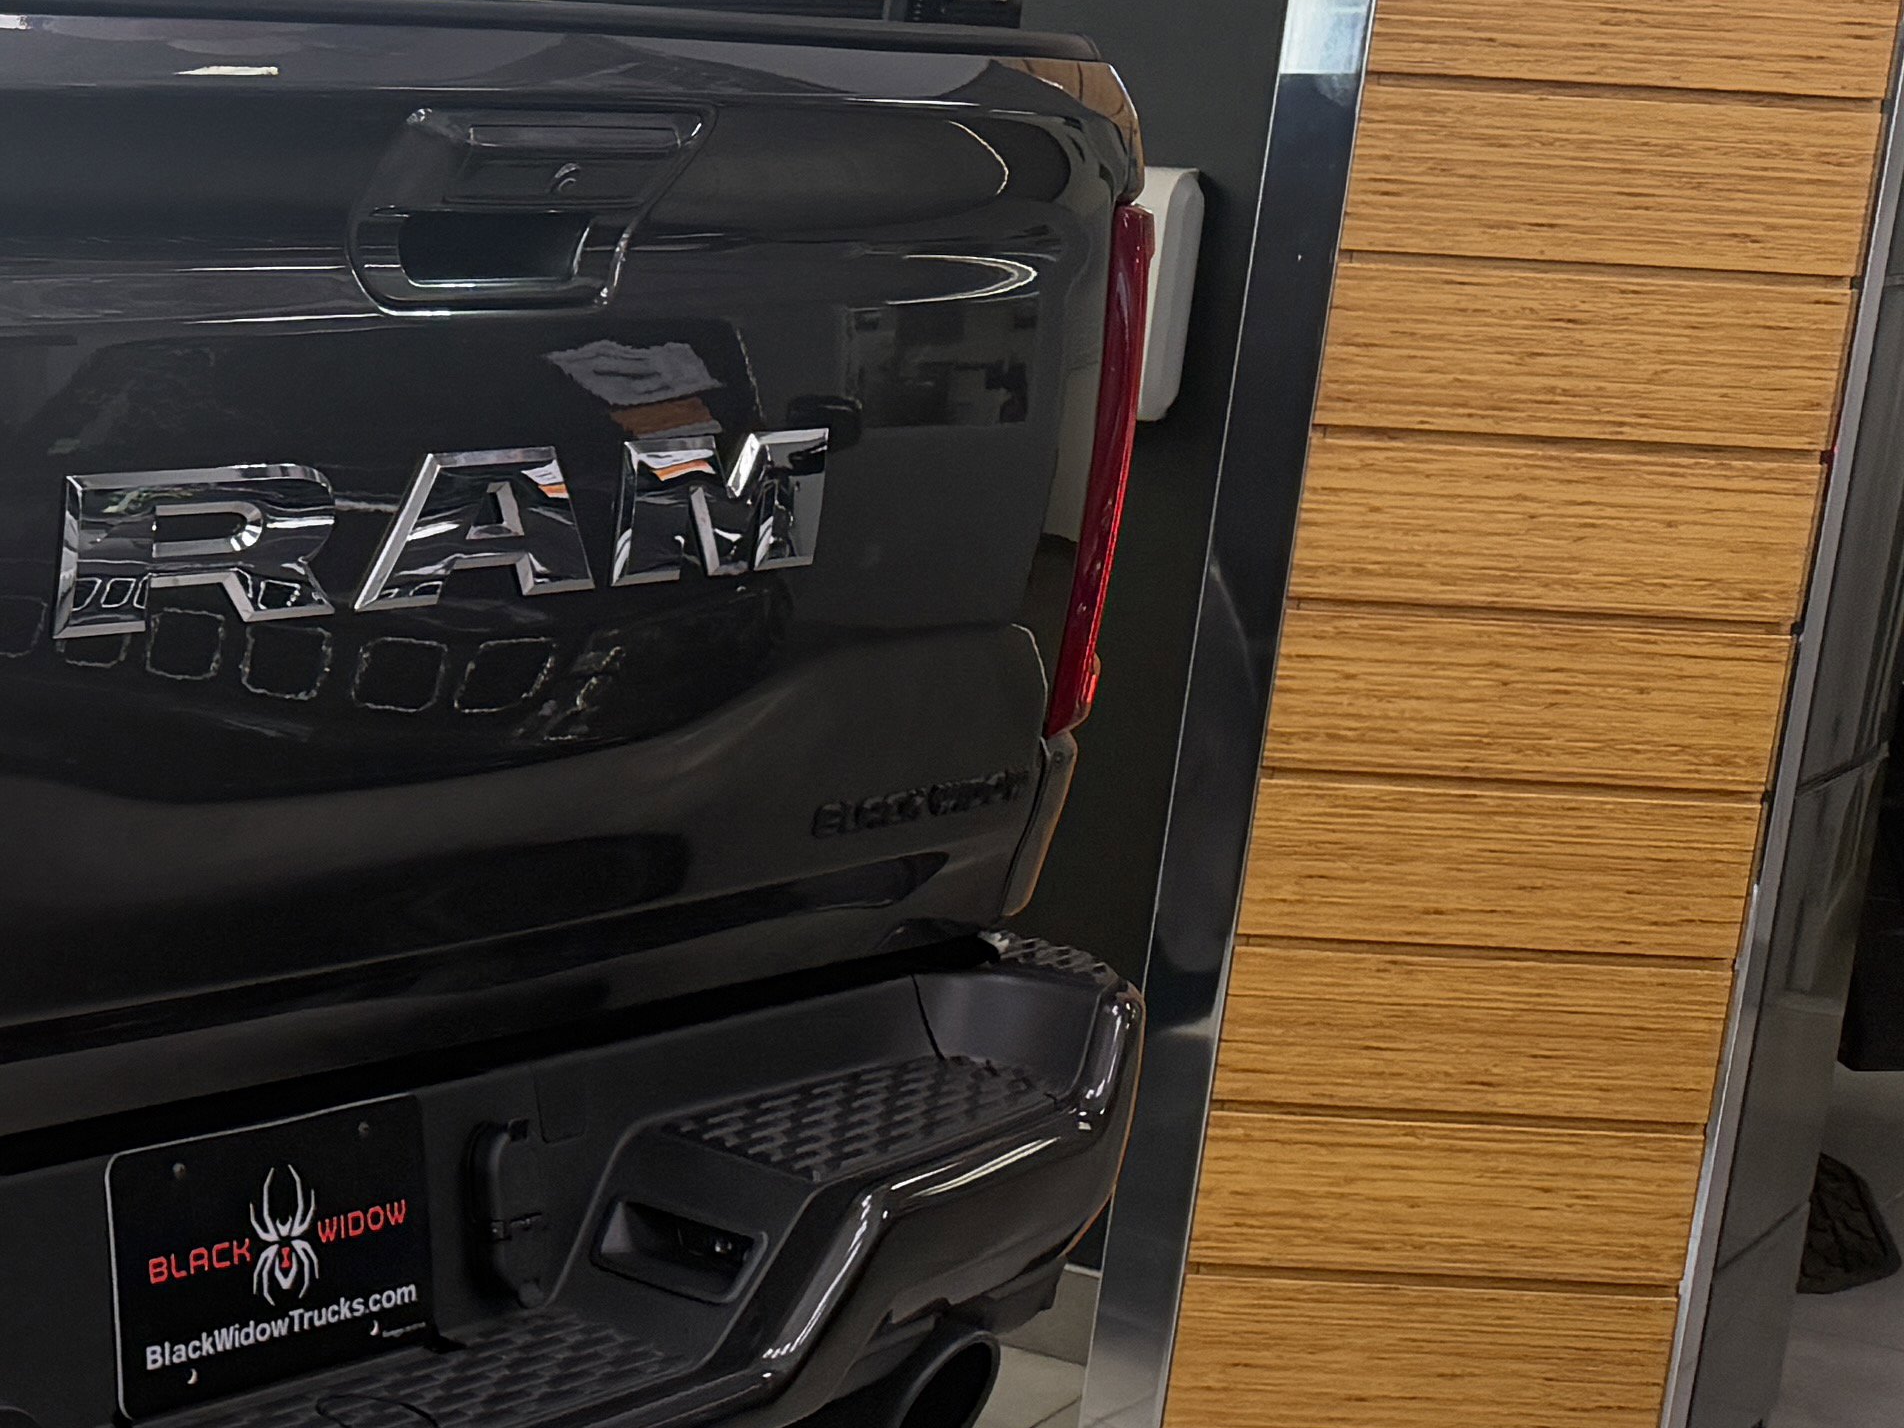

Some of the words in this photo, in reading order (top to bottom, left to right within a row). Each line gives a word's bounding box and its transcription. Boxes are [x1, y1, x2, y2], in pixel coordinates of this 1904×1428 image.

[50, 426, 831, 640] RAM
[148, 1238, 252, 1284] BLACK
[317, 1199, 407, 1244] WIDOW
[146, 1283, 418, 1371] BlackWidowTrucks.com
